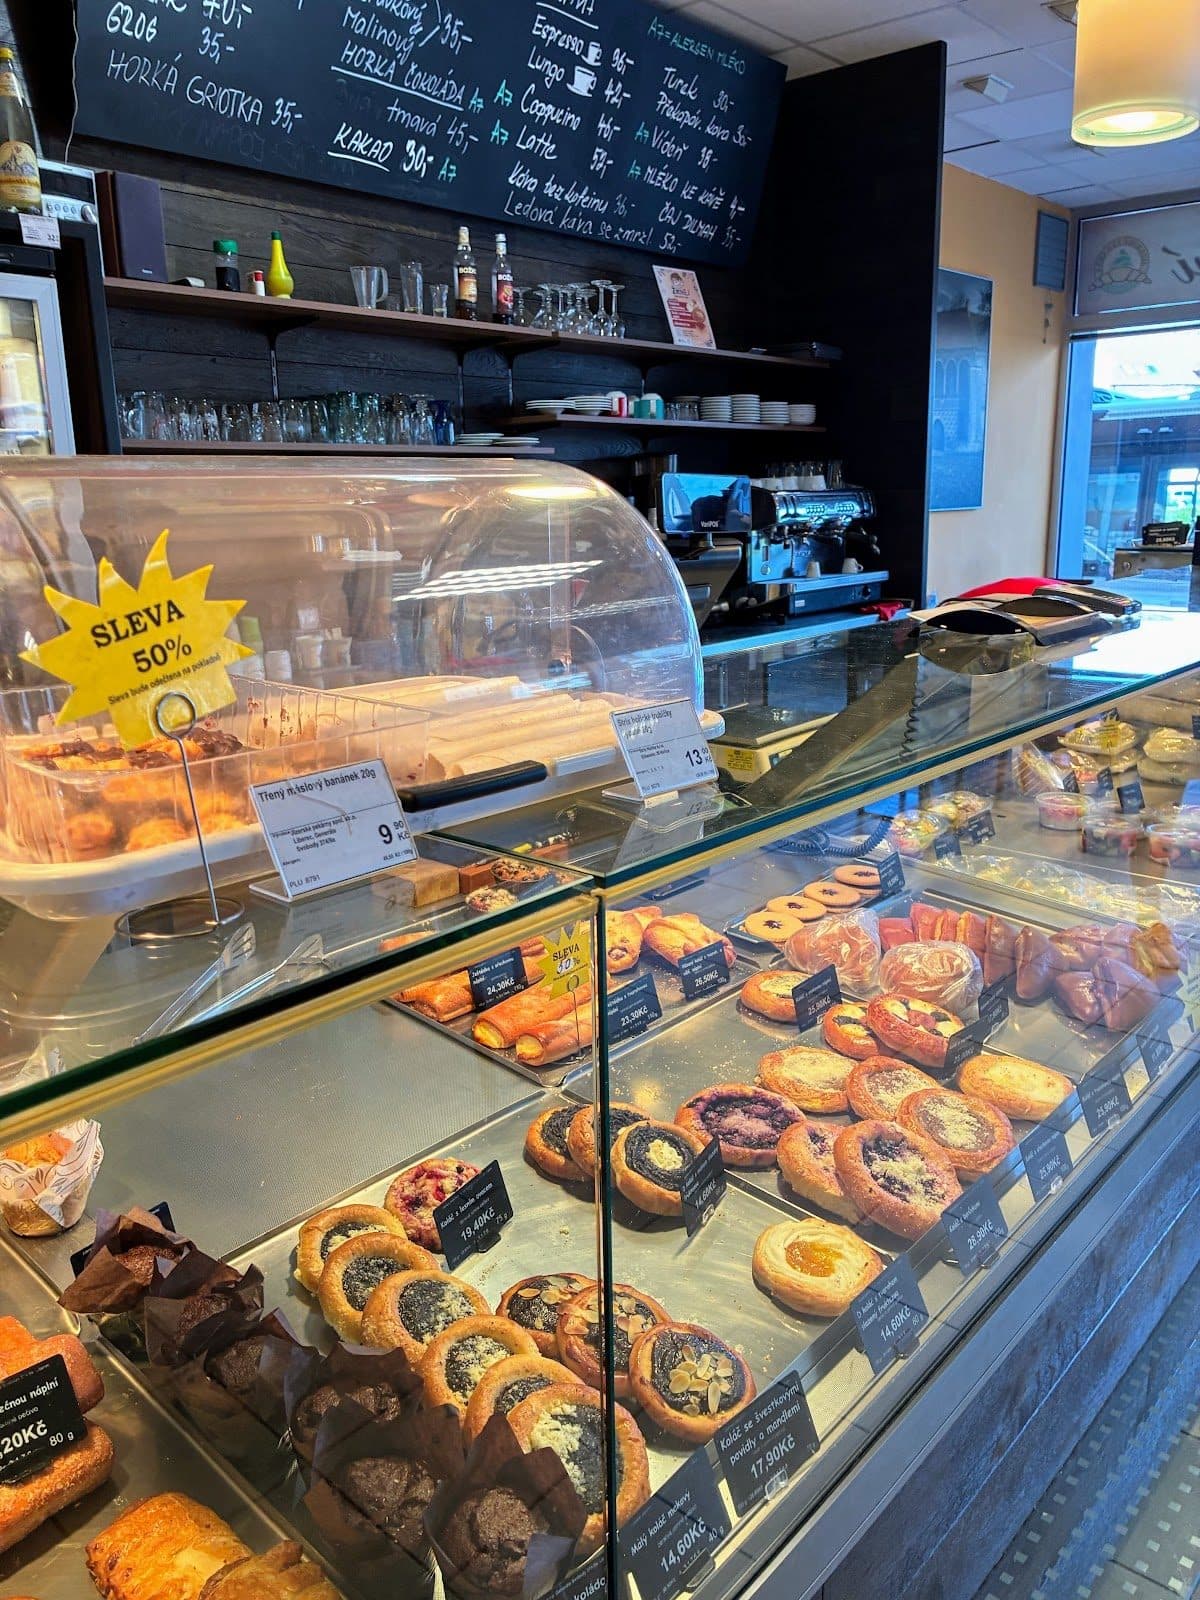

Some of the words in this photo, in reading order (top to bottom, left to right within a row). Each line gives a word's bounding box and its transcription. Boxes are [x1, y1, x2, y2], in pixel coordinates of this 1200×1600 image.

[198, 26, 235, 64] 35,-
[531, 14, 584, 55] Espresso
[527, 45, 565, 89] Lungo
[106, 49, 182, 96] HORKÁ
[186, 75, 263, 126] GRIOTKA
[271, 98, 303, 134] 35,-
[387, 98, 442, 137] tmavá
[446, 116, 479, 154] 45,-
[516, 125, 558, 160] Latte
[333, 122, 393, 164] KAKAO
[402, 139, 434, 178] 30,-
[644, 164, 678, 193] MLÉKO
[504, 190, 557, 225] Ledová
[90, 599, 184, 648] SLEVA
[132, 634, 192, 673] 50%
[685, 749, 703, 767] 13
[258, 787, 285, 802] Třený
[324, 773, 360, 788] banánek
[360, 768, 377, 779] 20g
[378, 824, 393, 845] 9
[398, 830, 410, 841] Kč
[553, 943, 580, 961] SLEVA
[486, 976, 515, 996] 24,30Kč
[621, 1004, 648, 1027] 23,30Kč
[461, 1206, 496, 1241] 19,40Kč
[880, 1305, 911, 1341] 14,60Kč
[29, 1377, 59, 1398] náplní
[720, 1425, 742, 1451] Koláč
[744, 1420, 754, 1433] se
[755, 1383, 800, 1423] švestkovými
[730, 1436, 757, 1466] povidly
[766, 1401, 801, 1435] mandlemi
[49, 1432, 63, 1447] 80
[67, 1431, 74, 1441] g
[751, 1434, 796, 1479] 17,90Kč
[630, 1532, 648, 1558] Malý
[648, 1513, 667, 1538] koláč
[667, 1487, 691, 1519] makový
[660, 1516, 707, 1573] 14,60Kč
